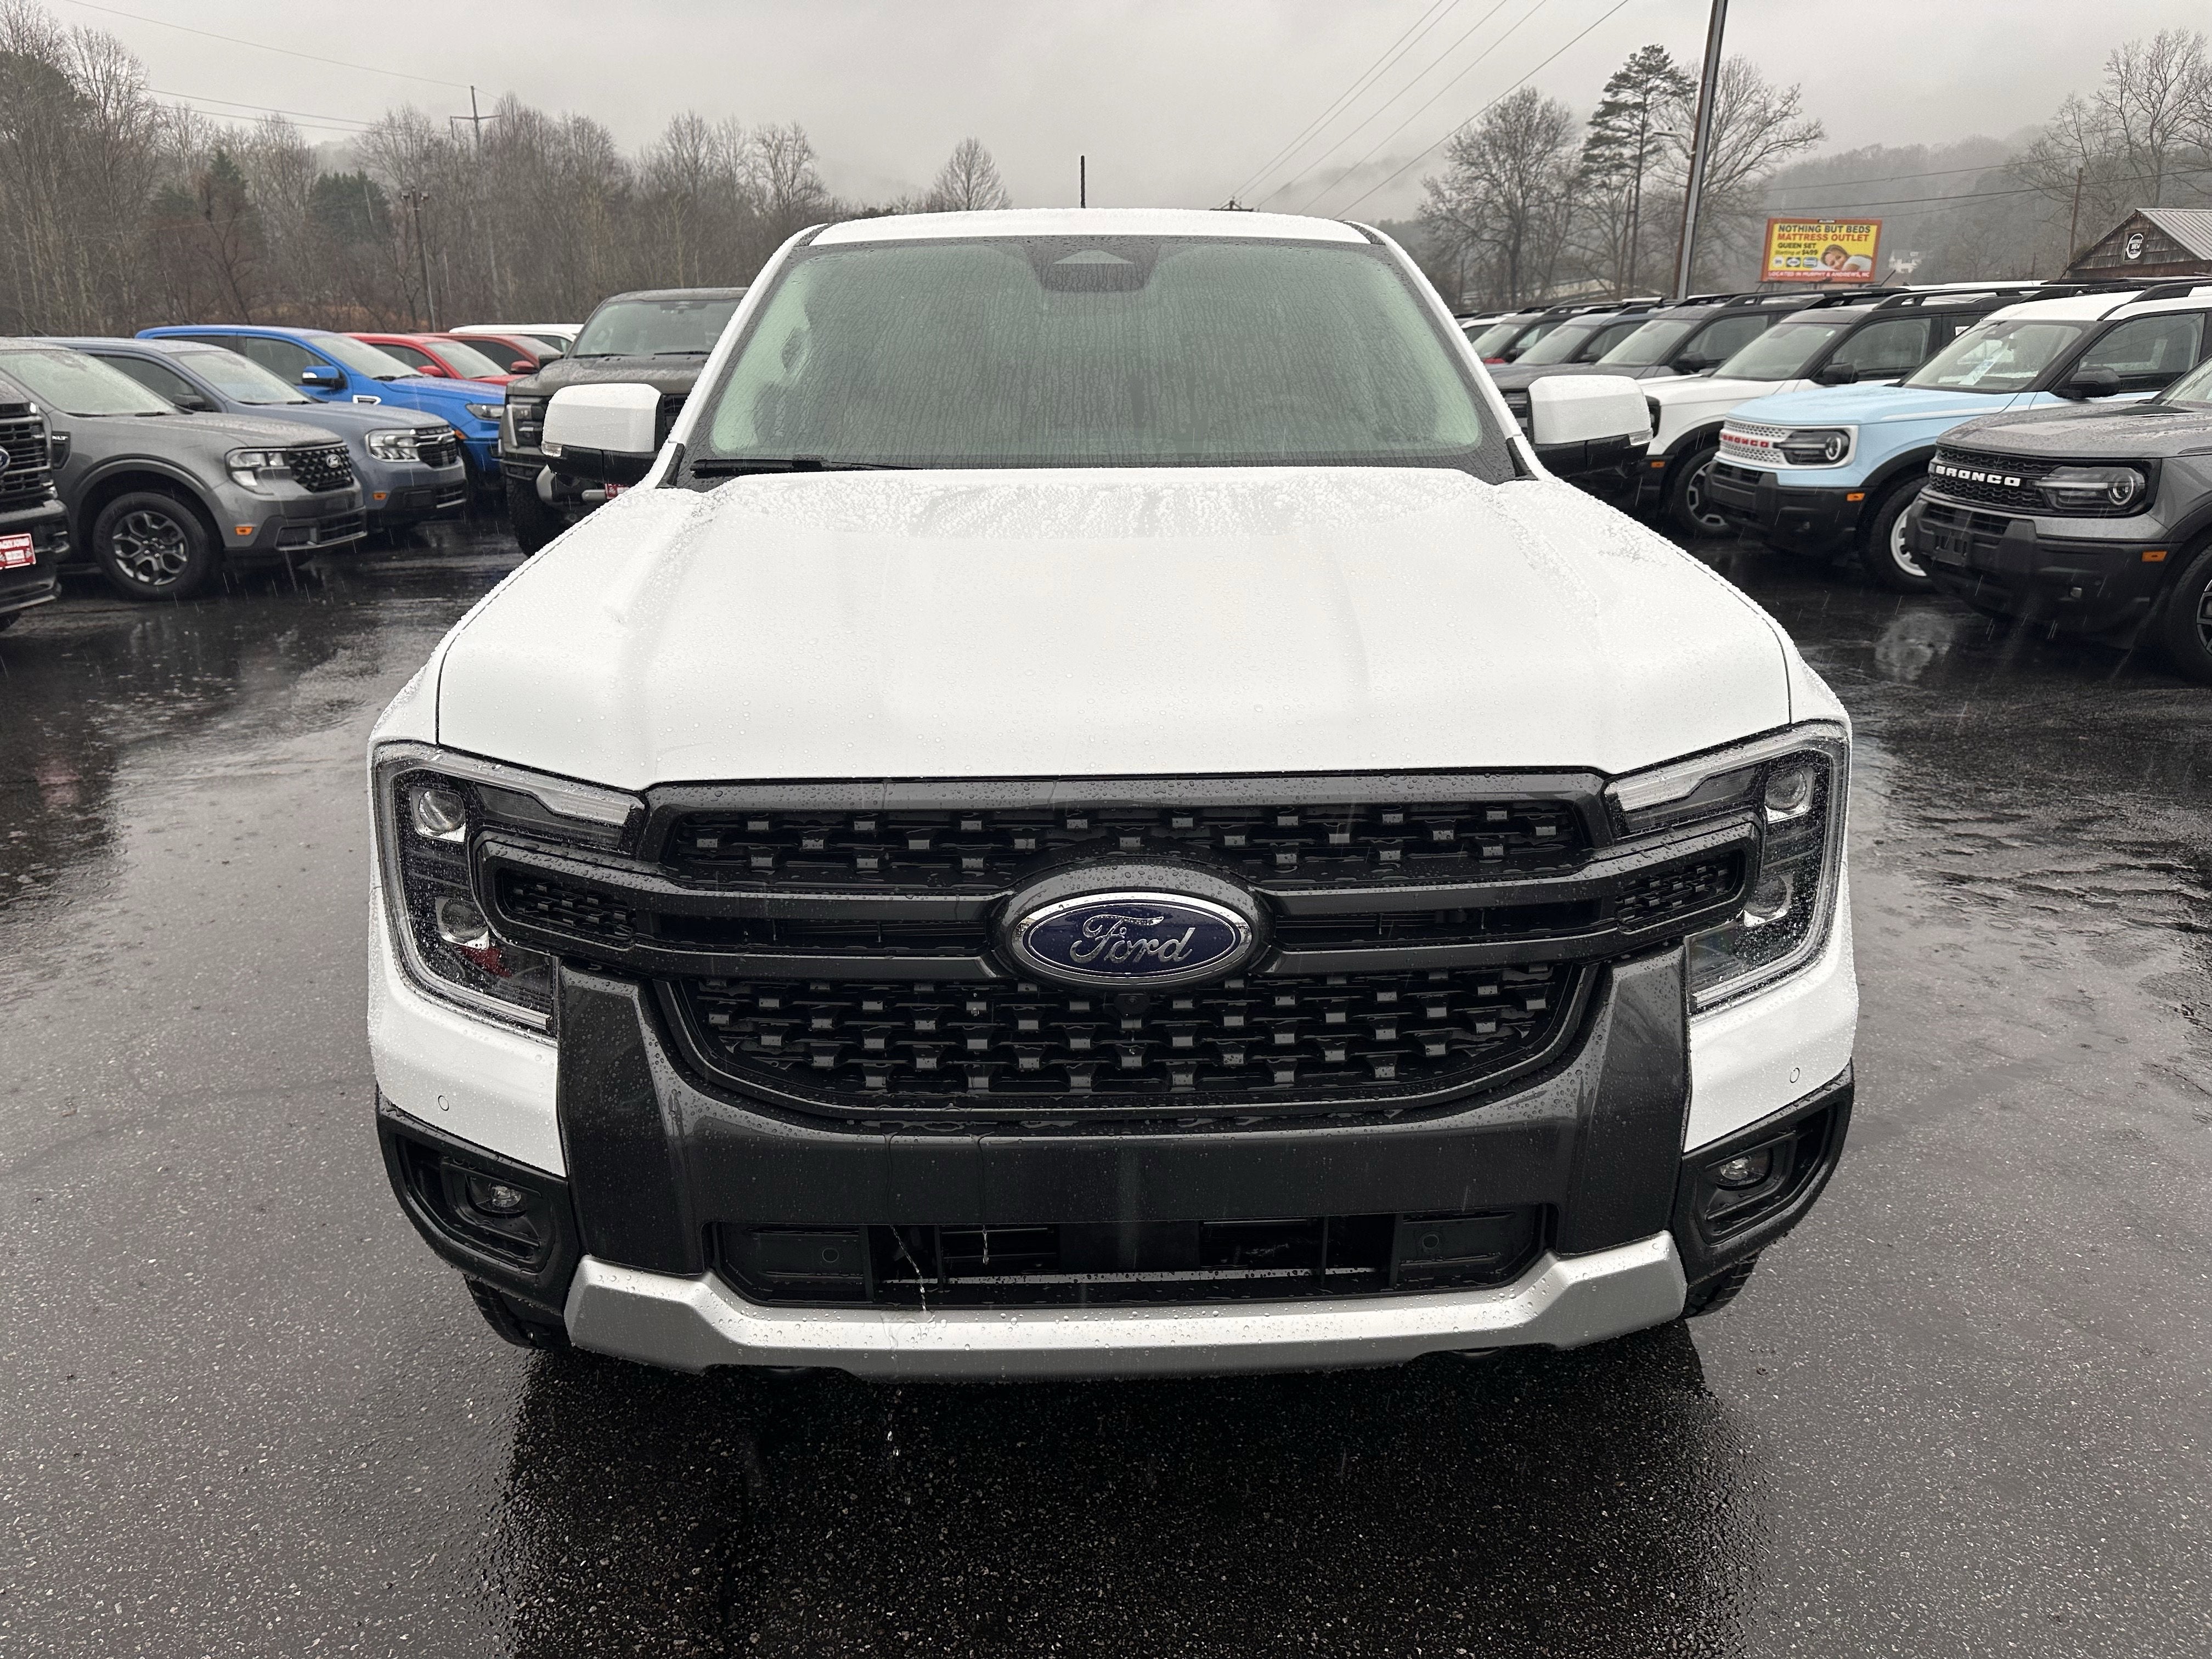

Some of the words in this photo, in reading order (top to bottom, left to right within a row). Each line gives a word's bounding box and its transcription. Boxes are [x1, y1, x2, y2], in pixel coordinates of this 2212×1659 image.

[1722, 435, 1769, 448] BRONCO
[1936, 465, 2021, 487] BRONCO
[1069, 913, 1196, 963] Ford
